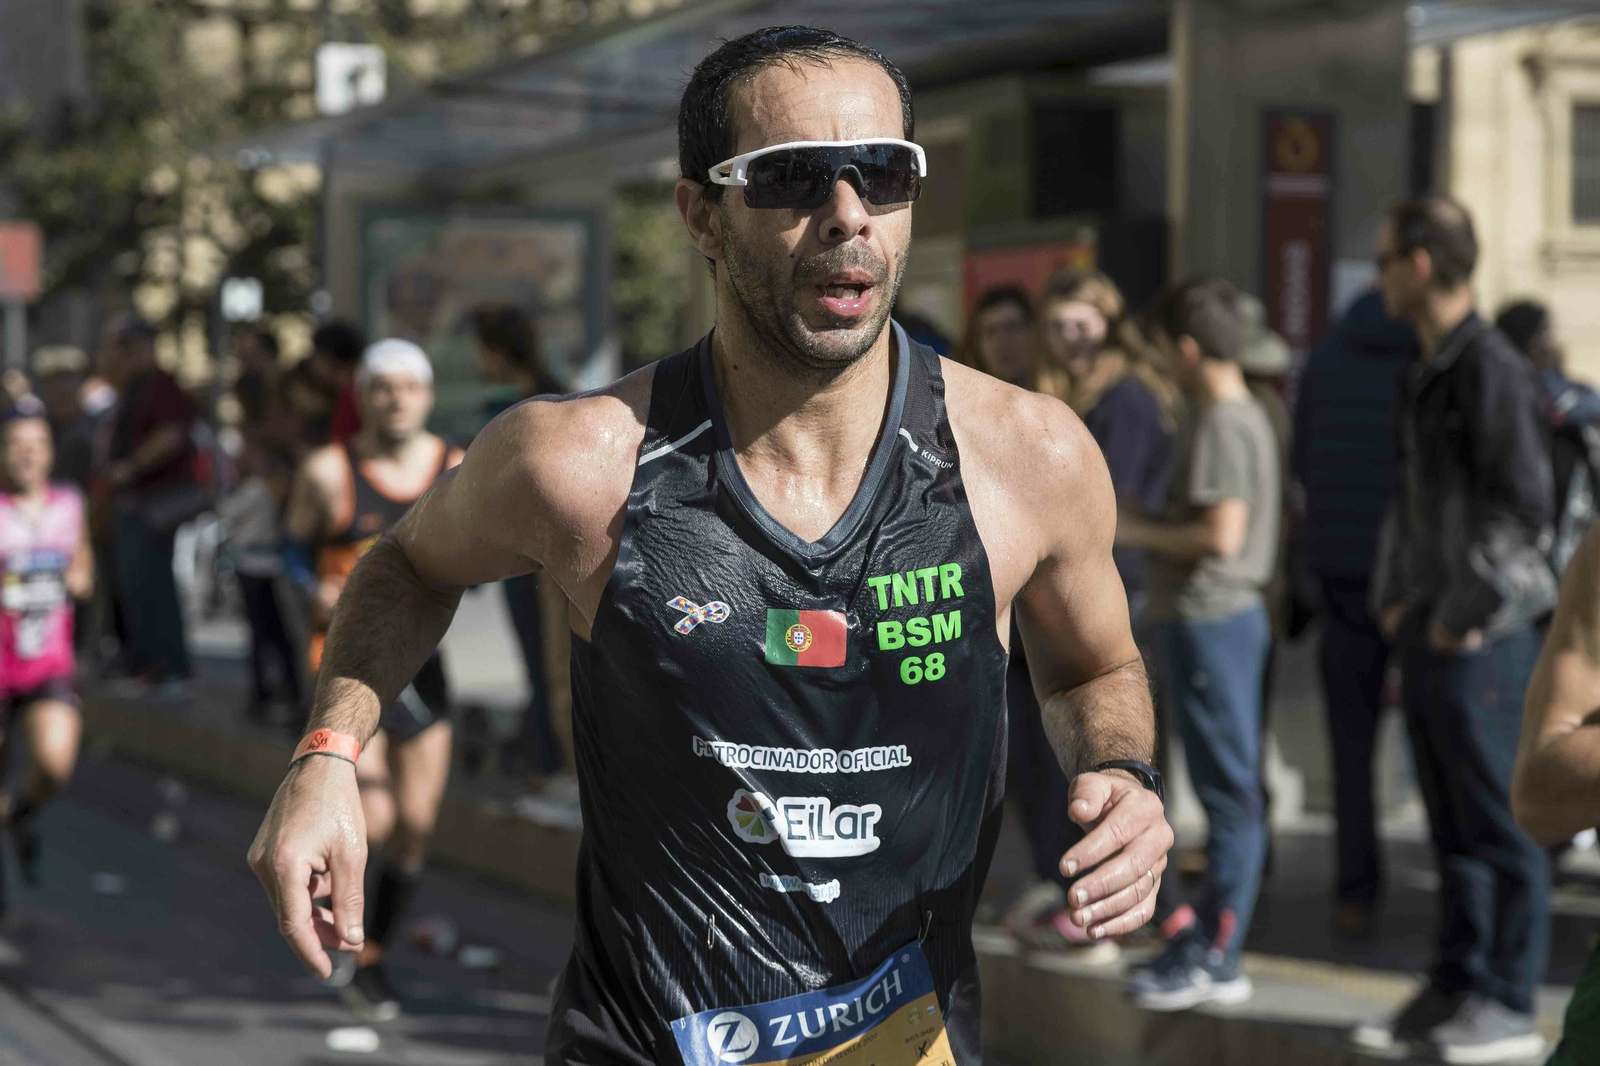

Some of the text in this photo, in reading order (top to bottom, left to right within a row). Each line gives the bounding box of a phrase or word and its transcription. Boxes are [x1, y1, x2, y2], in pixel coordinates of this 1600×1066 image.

[920, 449, 954, 469] KIPRUN
[868, 562, 965, 611] TNTR
[877, 609, 962, 651] BSM
[900, 652, 946, 685] 68
[838, 747, 910, 769] OFICIAL
[768, 968, 904, 1048] ZURICH
